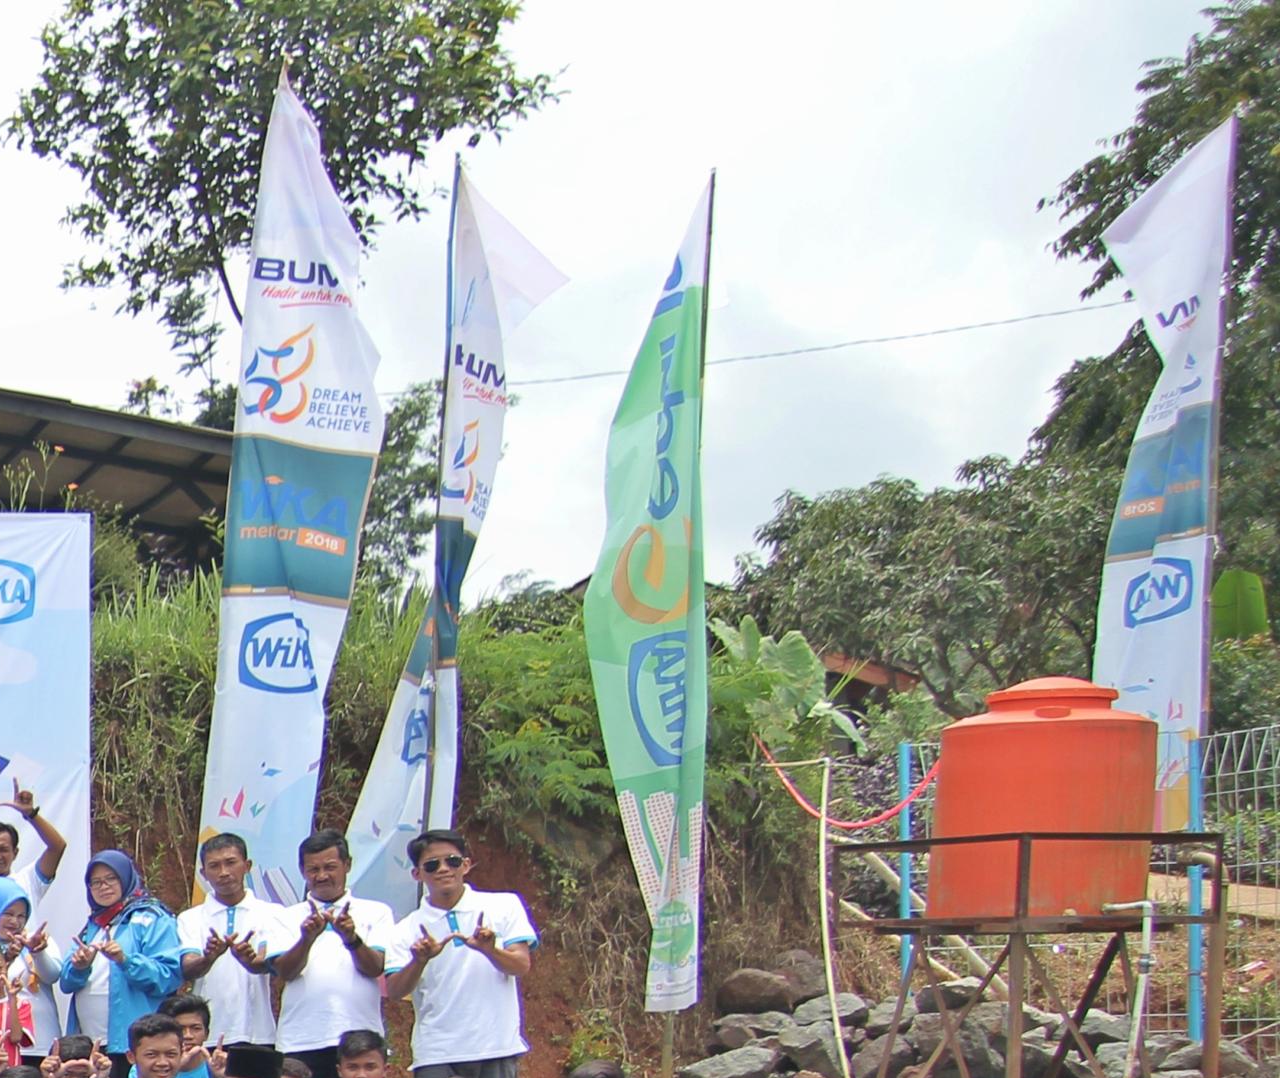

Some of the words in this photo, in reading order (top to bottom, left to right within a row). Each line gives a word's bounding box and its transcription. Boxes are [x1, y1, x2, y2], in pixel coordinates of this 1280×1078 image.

[253, 257, 339, 288] BUM
[260, 285, 296, 301] Hadir
[301, 288, 332, 304] untuk
[312, 388, 362, 404] DREAM
[308, 402, 368, 419] BELIEVE
[305, 417, 372, 433] ACHIEVE
[304, 532, 339, 550] 2018
